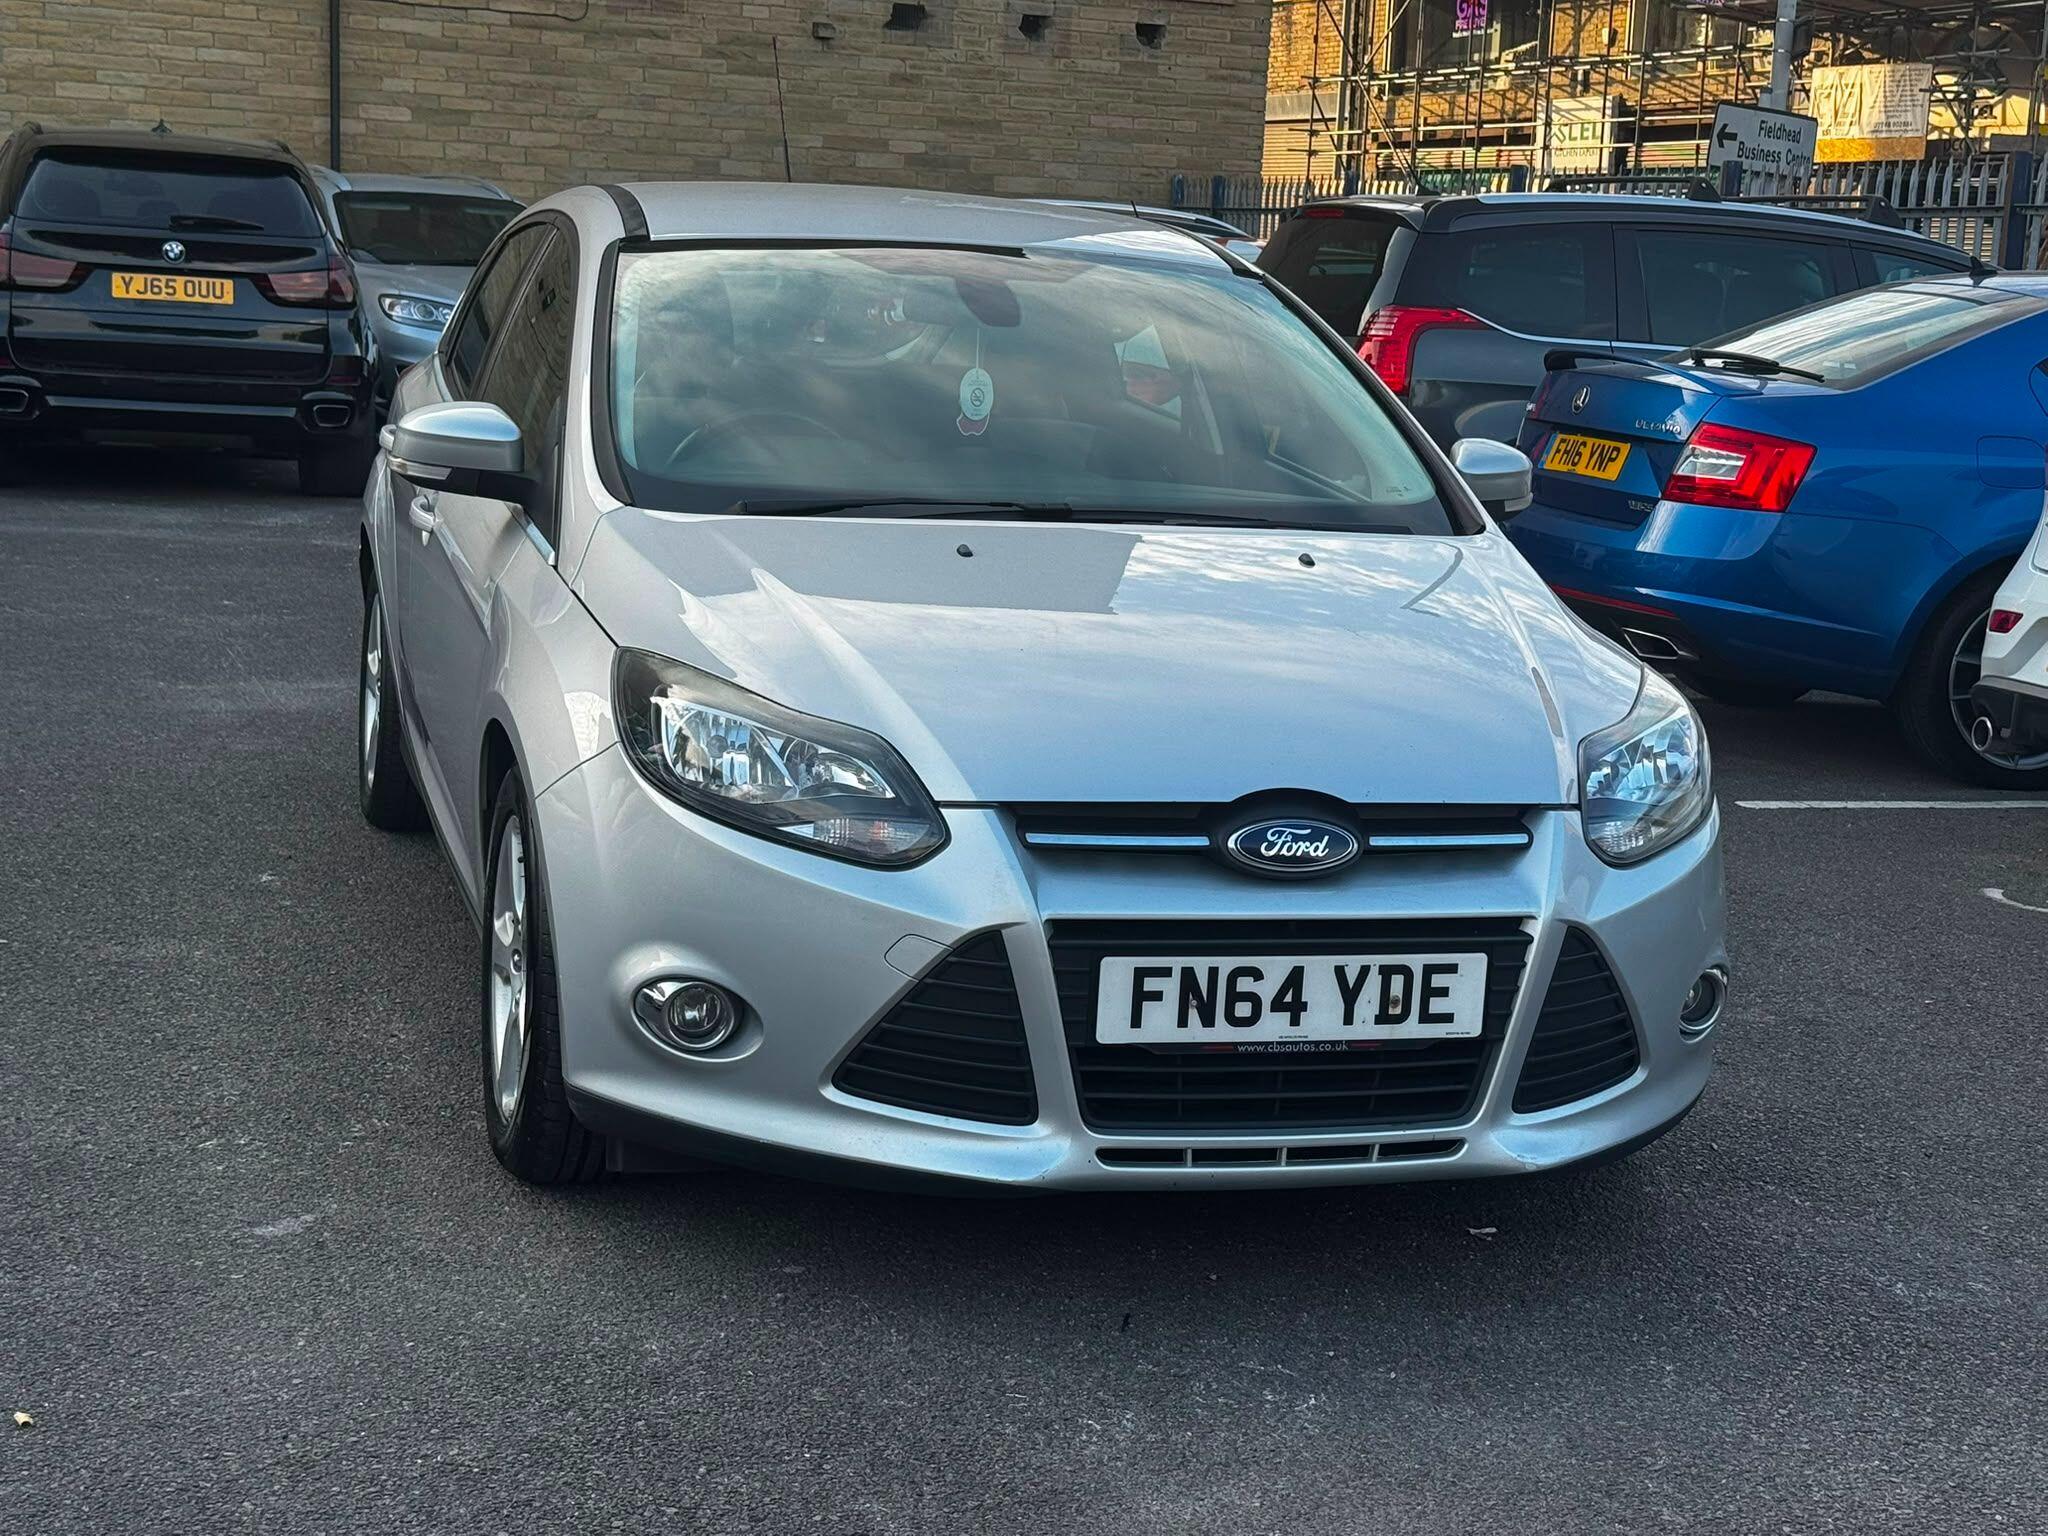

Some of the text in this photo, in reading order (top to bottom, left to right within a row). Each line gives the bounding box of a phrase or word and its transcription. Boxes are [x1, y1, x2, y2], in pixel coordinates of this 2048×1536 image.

[1758, 120, 1801, 144] Fieldhead
[1737, 141, 1811, 166] Business Centre
[121, 275, 224, 299] YJ65 OUU
[1551, 438, 1621, 472] FH16 YNP
[1260, 827, 1330, 857] Ford
[1129, 963, 1459, 1029] FN64 YDE
[1237, 1041, 1349, 1053] www.cbsautos.co.uk
